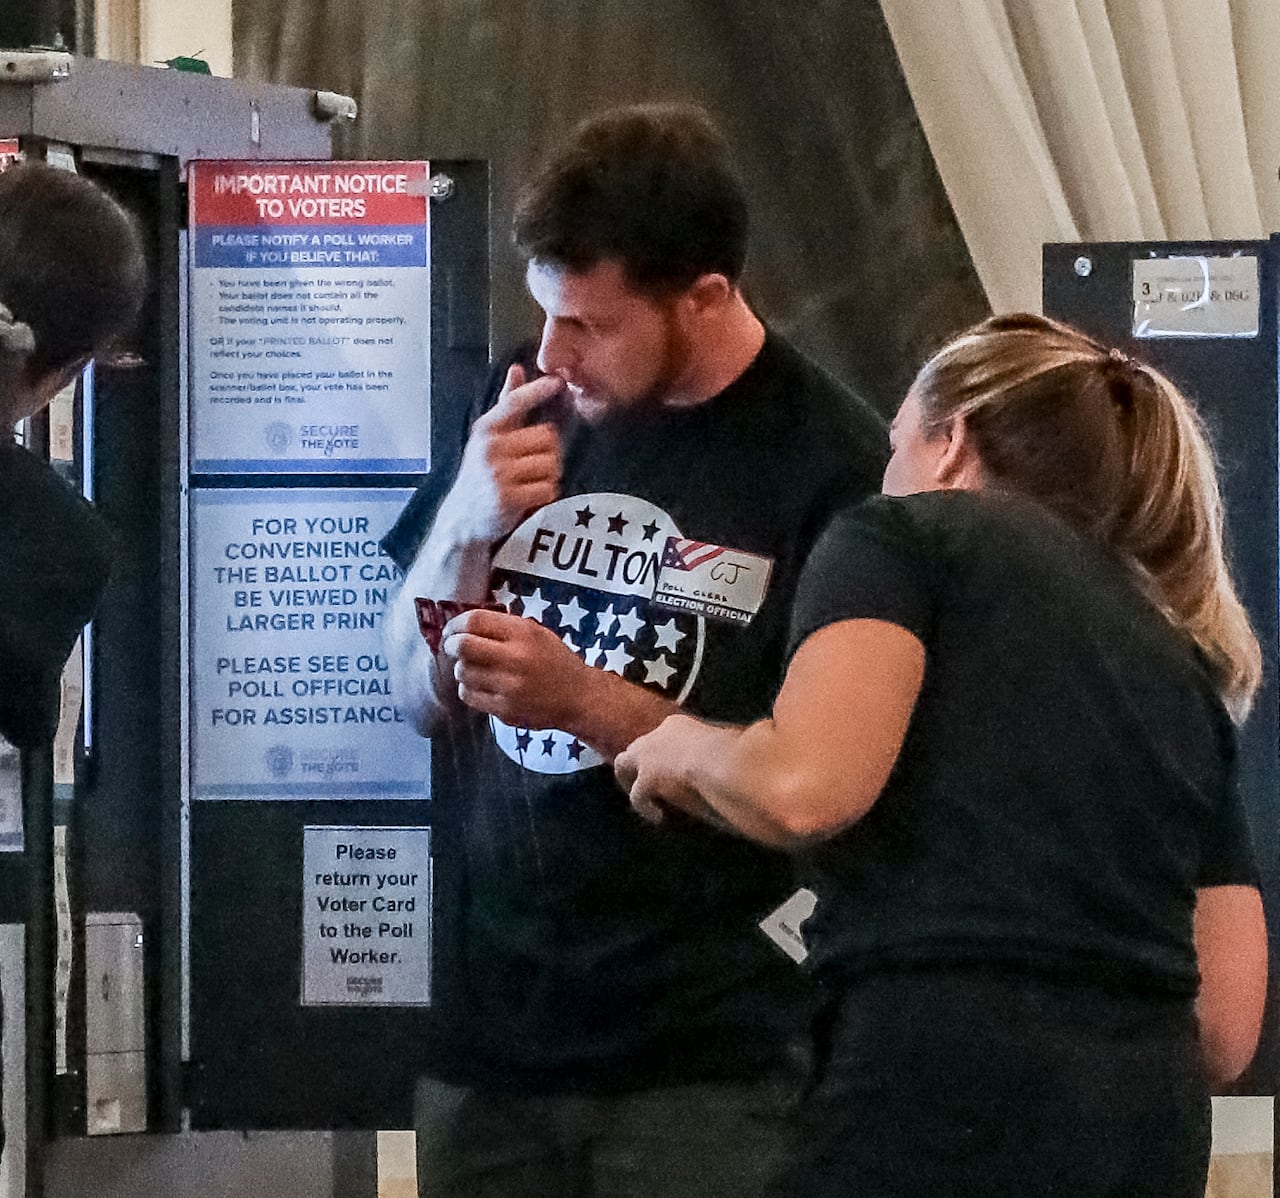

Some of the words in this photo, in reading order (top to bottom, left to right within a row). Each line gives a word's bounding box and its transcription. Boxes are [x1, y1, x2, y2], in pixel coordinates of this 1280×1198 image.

[214, 174, 332, 195] IMPORTANT
[335, 174, 408, 194] NOTICE
[256, 198, 284, 218] TO
[288, 198, 366, 218] VOTERS
[212, 235, 258, 246] PLEASE
[262, 235, 308, 246] NOTIFY
[311, 235, 321, 246] A
[324, 235, 355, 246] POLL
[358, 235, 413, 246] WORKER
[246, 251, 257, 262] IF
[261, 251, 286, 262] YOU
[291, 251, 341, 262] BELIEVE
[344, 251, 380, 262] THAT:
[219, 279, 236, 288] You
[238, 279, 262, 288] have
[264, 279, 286, 288] been
[289, 279, 315, 290] given
[317, 279, 331, 288] the
[334, 280, 363, 290] wrong
[367, 279, 395, 288] ballot.
[1142, 282, 1150, 296] 3
[219, 291, 239, 300] Your
[241, 291, 268, 300] ballot
[271, 291, 293, 300] does
[296, 291, 311, 300] not
[314, 291, 347, 300] contain
[350, 291, 361, 300] all
[364, 291, 379, 300] the
[219, 304, 264, 312] candidate
[267, 304, 297, 312] names
[300, 304, 306, 312] it
[309, 304, 342, 312] should.
[219, 316, 236, 325] The
[239, 316, 268, 326] voting
[271, 316, 289, 325] unit
[291, 316, 297, 325] is
[300, 316, 315, 325] not
[319, 316, 362, 326] operating
[365, 316, 406, 326] properly.
[210, 338, 224, 346] OR
[227, 338, 233, 346] if
[235, 338, 256, 348] your
[258, 337, 306, 345] "PRINTED
[308, 337, 350, 345] BALLOT"
[353, 337, 375, 345] does
[378, 337, 393, 345] not
[210, 350, 239, 358] reflect
[242, 351, 263, 360] your
[266, 350, 302, 358] choices.
[210, 371, 234, 379] Once
[238, 372, 253, 381] you
[256, 371, 279, 379] have
[282, 371, 312, 381] placed
[315, 372, 335, 381] your
[338, 370, 364, 378] ballot
[367, 370, 375, 378] in
[378, 370, 392, 378] the
[210, 384, 276, 392] scanner/ballot
[279, 383, 297, 392] box,
[300, 384, 320, 394] your
[347, 383, 363, 391] has
[365, 383, 389, 391] been
[210, 396, 252, 404] recorded
[255, 396, 271, 404] and
[274, 396, 281, 404] is
[284, 396, 306, 404] final.
[300, 425, 359, 436] SECURE
[301, 439, 327, 449] THE
[252, 518, 296, 536] FOR
[304, 517, 368, 534] YOUR
[214, 566, 257, 584] THE
[265, 565, 352, 583] BALLOT
[710, 561, 750, 584] CJ
[662, 582, 685, 592] POLL
[234, 590, 262, 607] BE
[269, 589, 357, 606] VIEWED
[365, 588, 388, 606] IN
[656, 594, 705, 612] ELECTION
[226, 613, 315, 632] LARGER
[216, 656, 301, 674] PLEASE
[308, 656, 349, 673] SEE
[228, 680, 284, 698] POLL
[211, 708, 257, 726] FOR
[336, 844, 396, 860] Please
[315, 872, 370, 886] return
[376, 874, 418, 890] your
[317, 896, 367, 912] Voter
[372, 896, 415, 912] Card
[320, 924, 337, 938] to
[344, 923, 371, 938] the
[378, 923, 413, 938] Poll
[330, 949, 402, 964] Worker.
